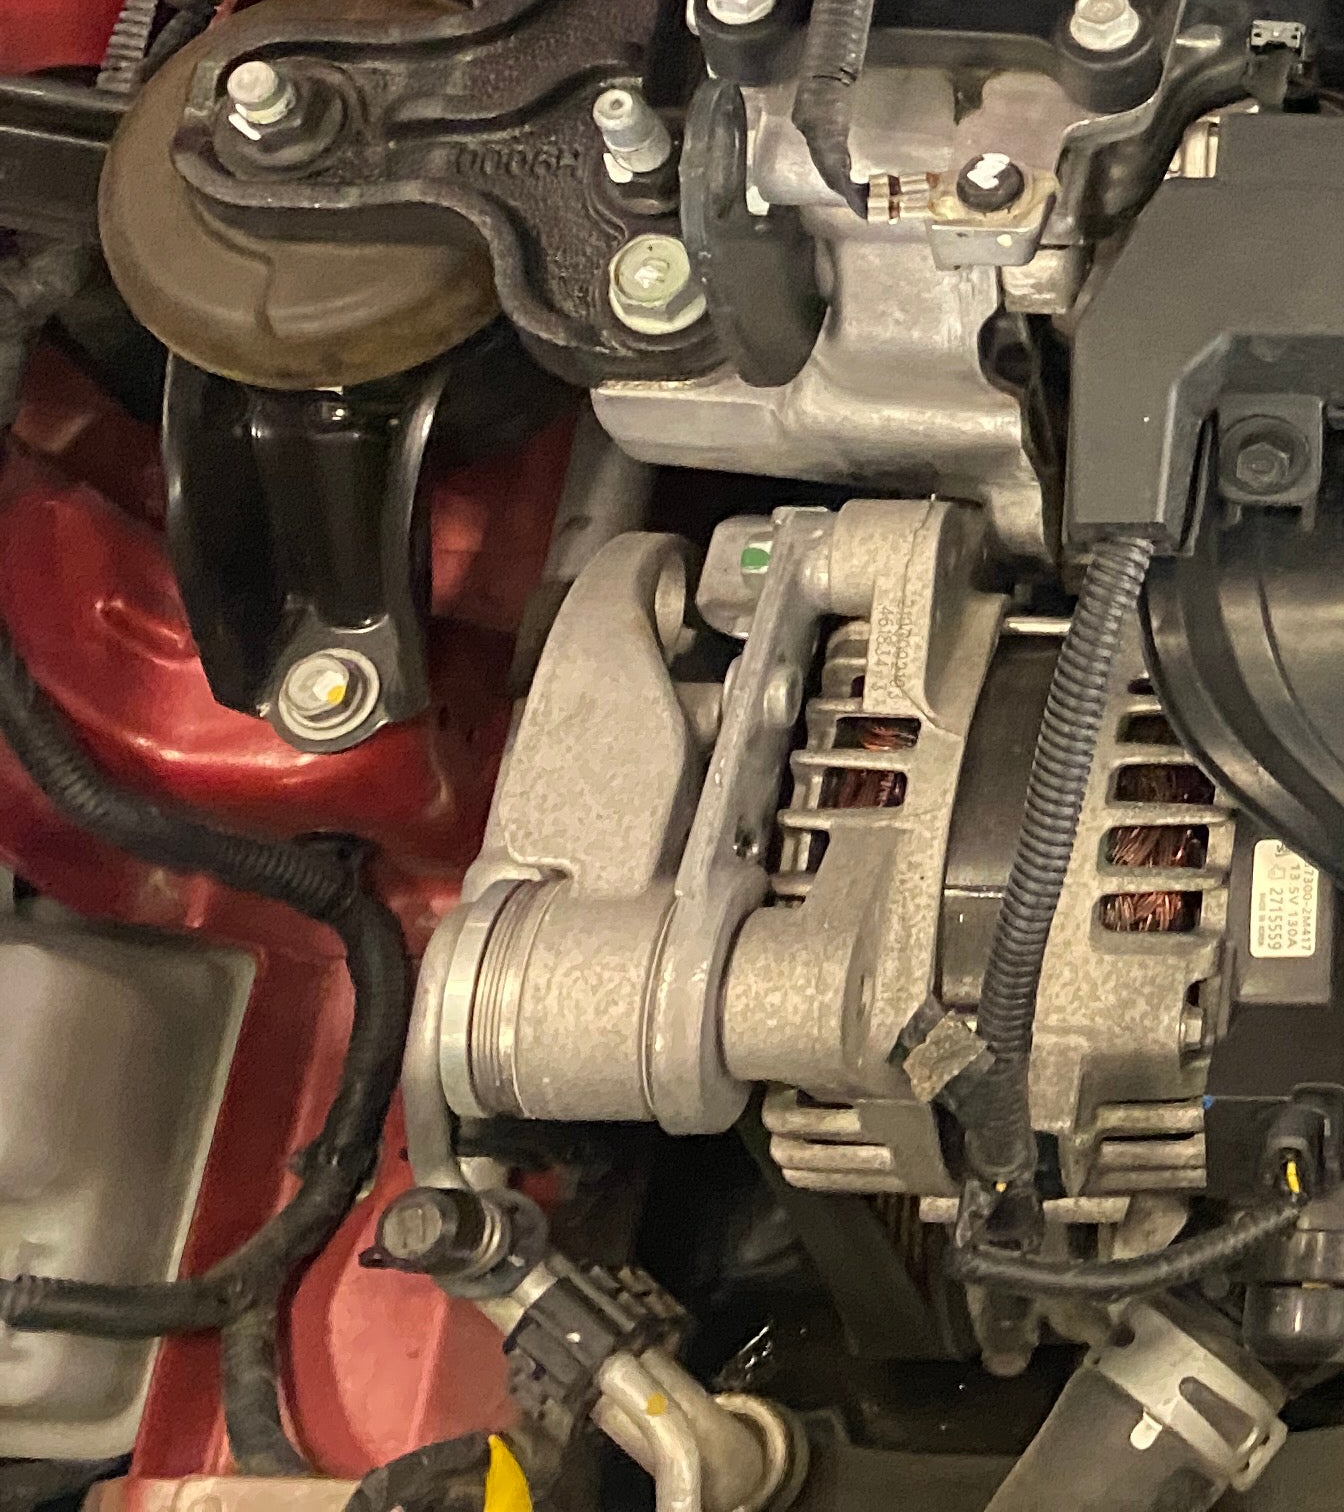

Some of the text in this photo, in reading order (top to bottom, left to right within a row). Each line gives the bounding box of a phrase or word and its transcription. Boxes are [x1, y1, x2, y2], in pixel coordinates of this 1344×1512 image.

[1267, 887, 1284, 951] 2715559
[1287, 863, 1300, 950] 13.5V 130A
[1301, 864, 1315, 951] 7300-2M417
